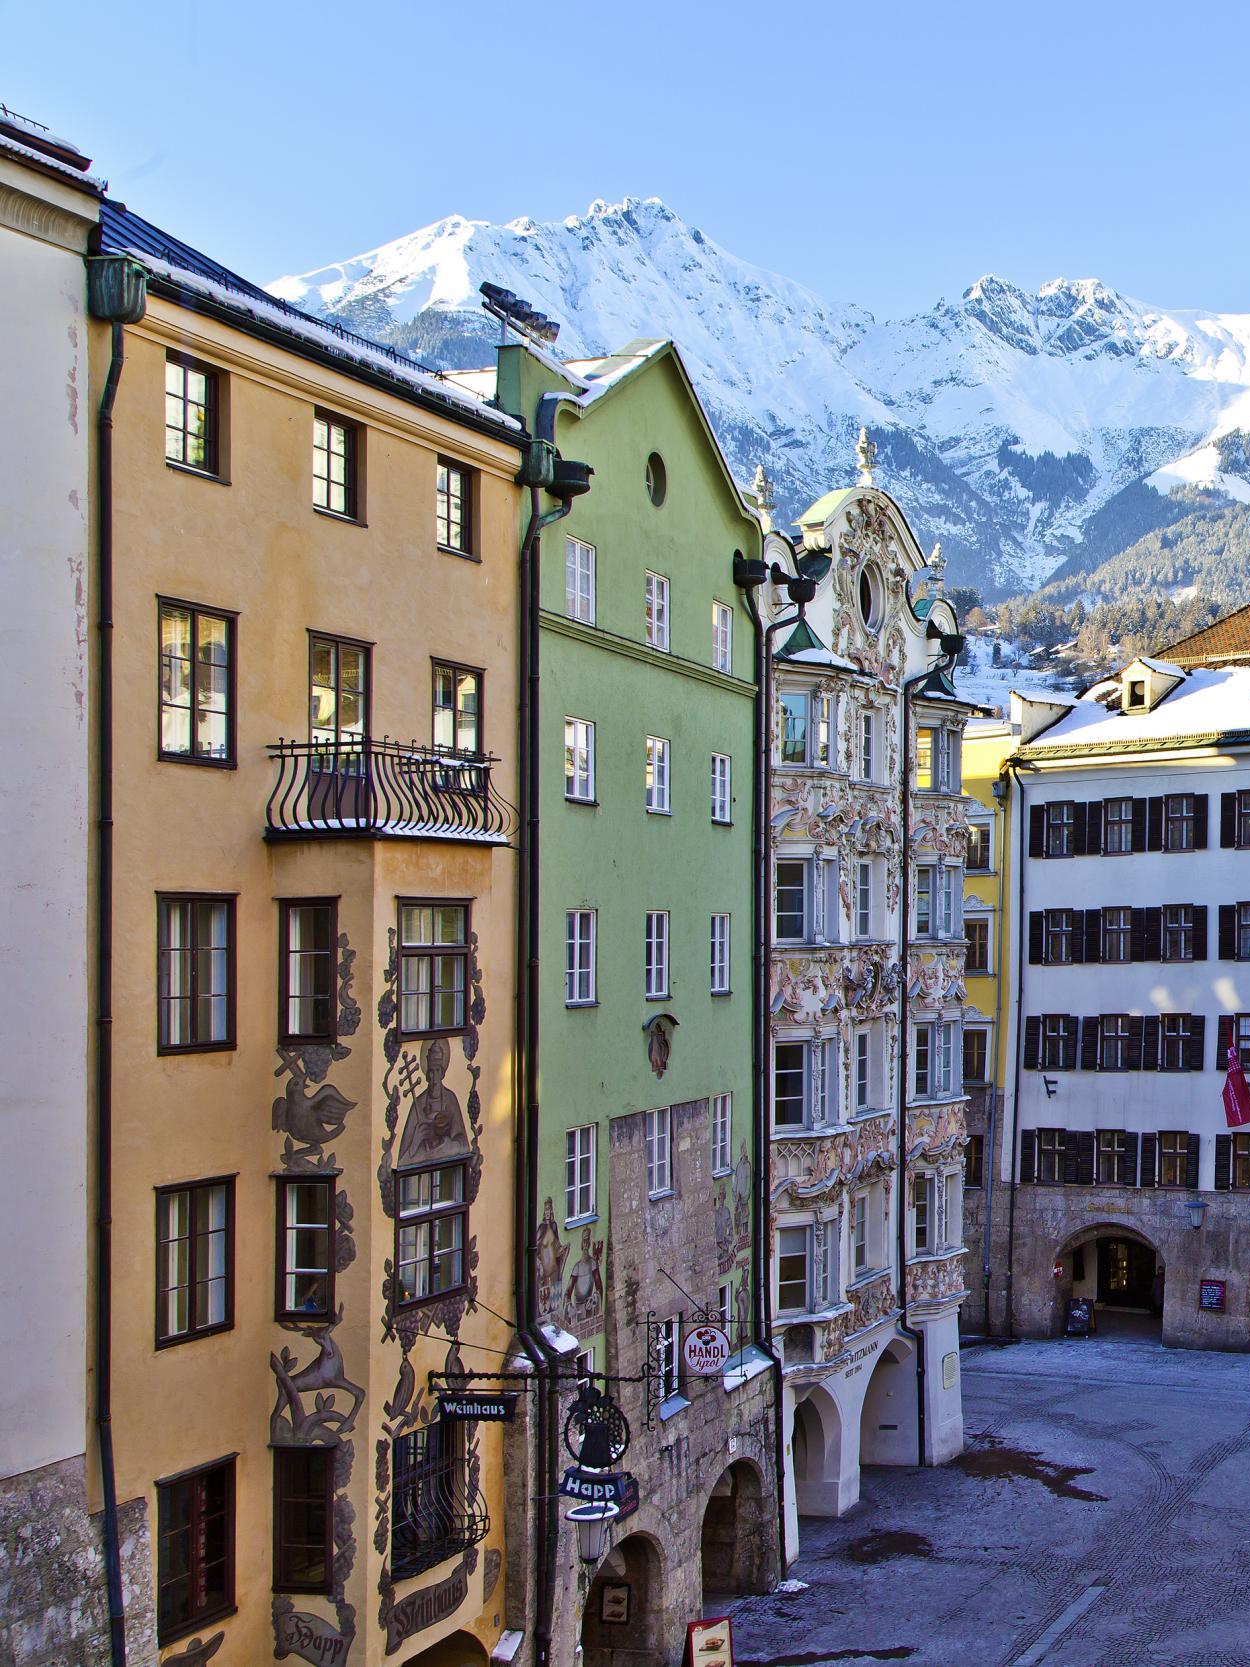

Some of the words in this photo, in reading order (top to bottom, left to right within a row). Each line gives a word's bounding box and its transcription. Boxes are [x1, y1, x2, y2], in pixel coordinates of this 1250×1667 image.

[688, 1343, 726, 1359] HANDL
[690, 1355, 721, 1372] Tyrol
[443, 1400, 506, 1415] Weinhaus
[565, 1477, 616, 1499] Happ
[393, 1577, 464, 1638] Weinhaus
